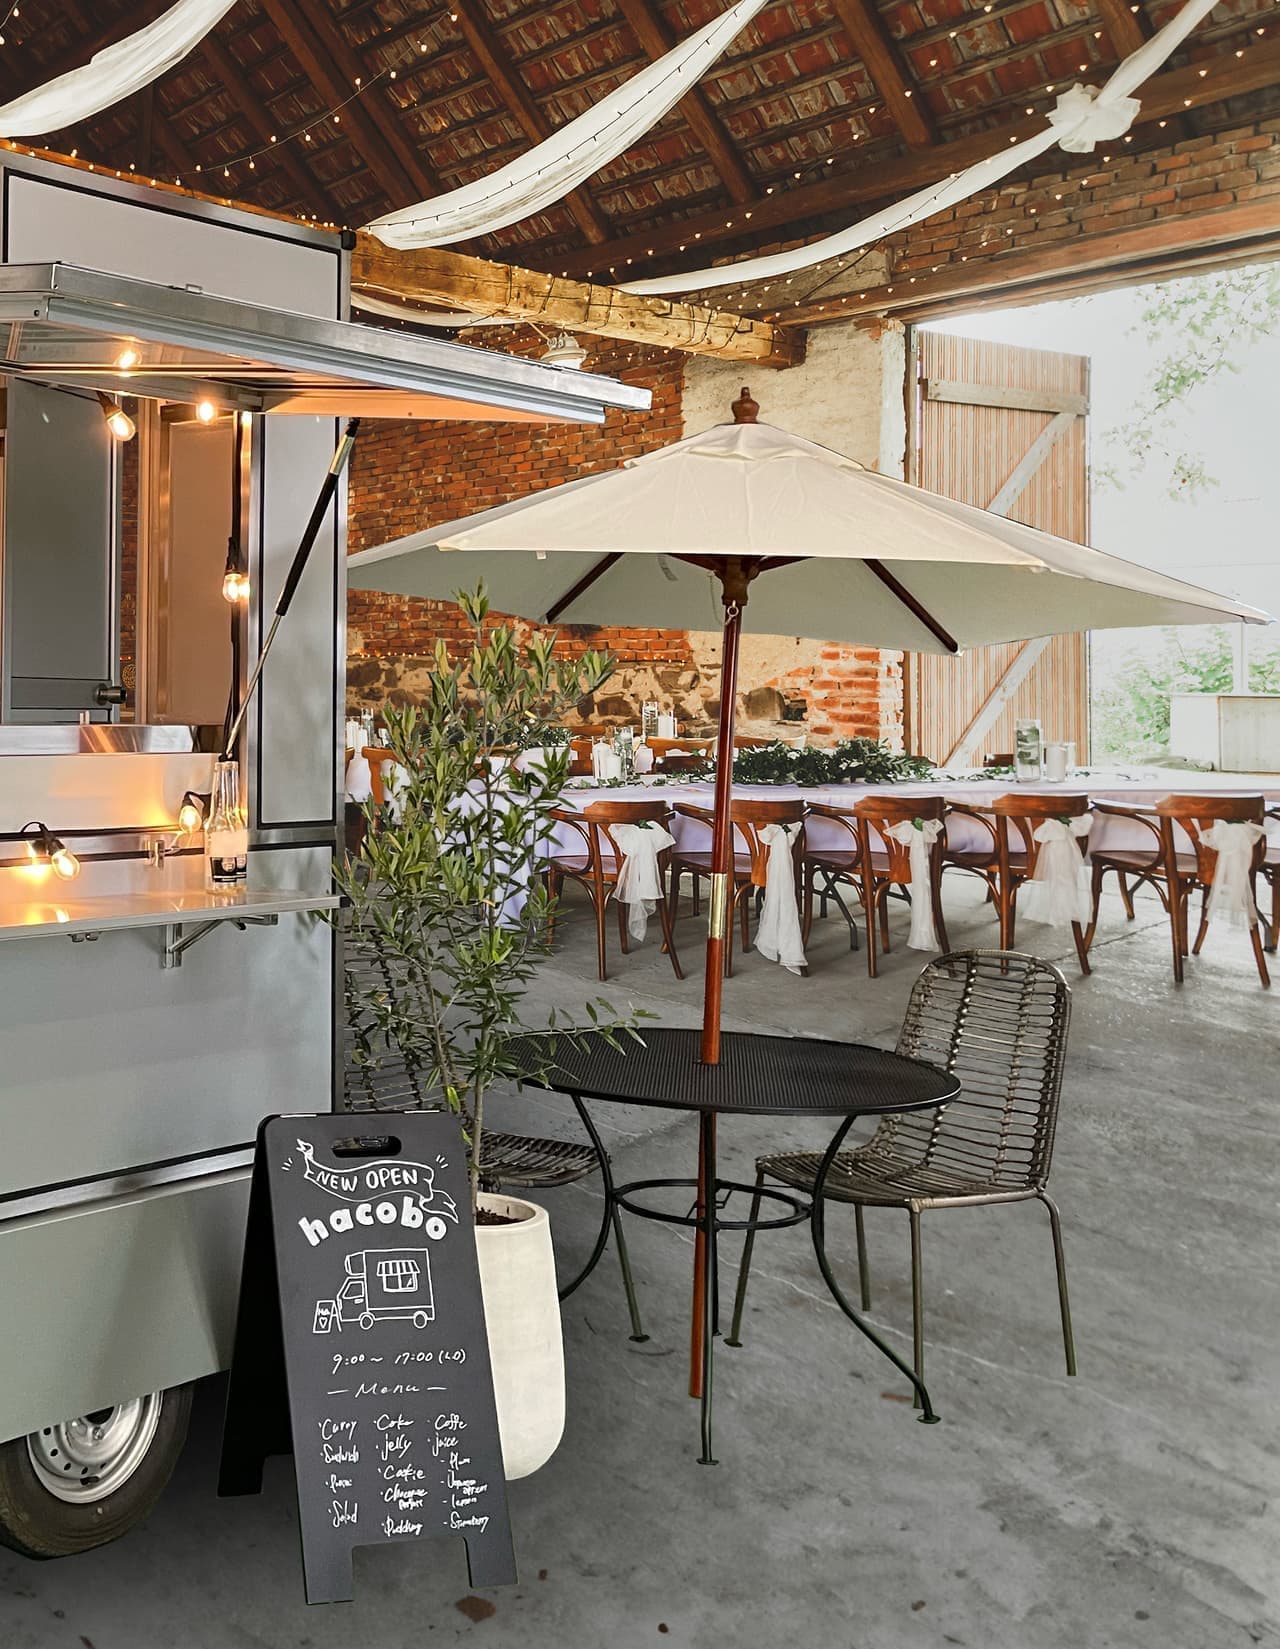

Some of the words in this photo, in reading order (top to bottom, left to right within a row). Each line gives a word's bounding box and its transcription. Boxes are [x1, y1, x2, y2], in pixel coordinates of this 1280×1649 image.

[316, 1171, 358, 1193] NEW
[365, 1167, 418, 1189] OPEN
[298, 1196, 447, 1247] hacobo
[332, 1354, 365, 1374] 9:00
[394, 1352, 433, 1365] 17:00
[354, 1383, 420, 1398] Menu
